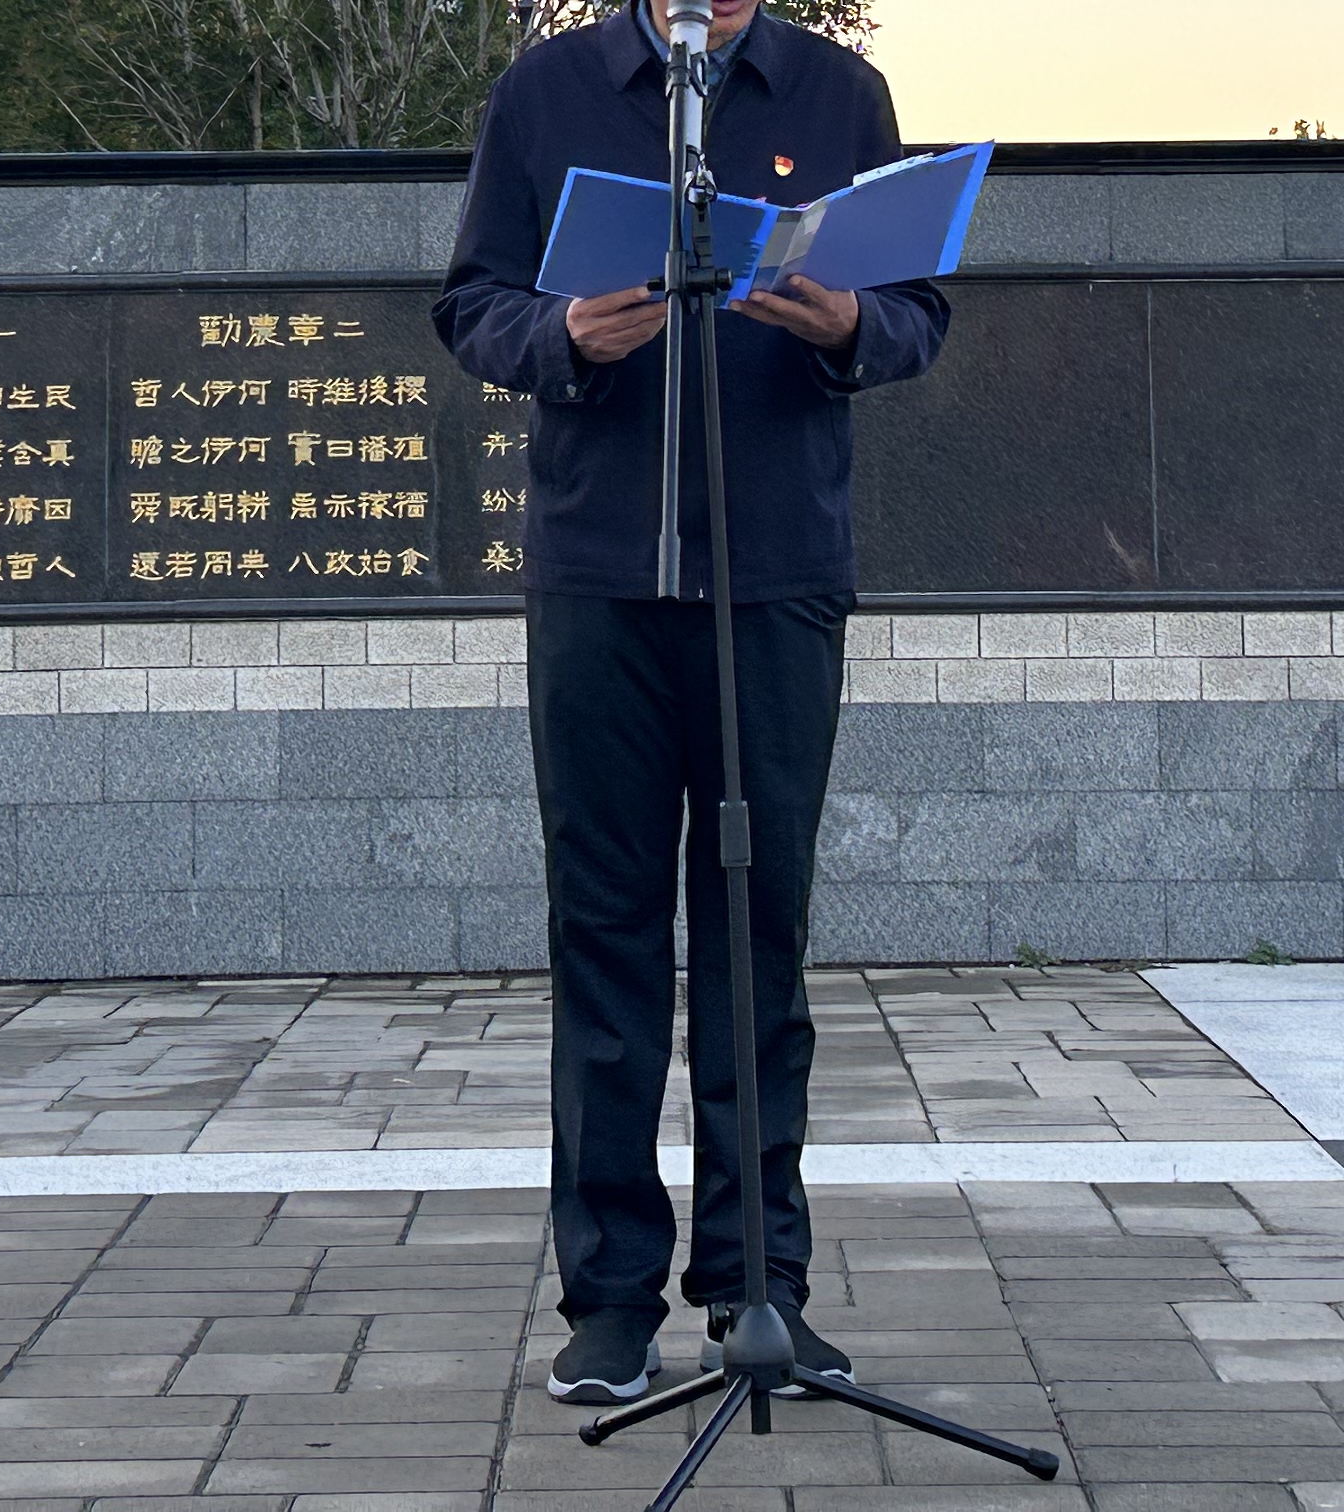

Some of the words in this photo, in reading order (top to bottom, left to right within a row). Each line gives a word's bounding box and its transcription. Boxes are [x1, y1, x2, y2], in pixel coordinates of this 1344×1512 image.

[198, 313, 365, 348] 勸農章二
[130, 377, 273, 408] 哲人伊何
[287, 375, 428, 407] 時維後稷
[130, 435, 272, 469] 贍之伊何
[129, 490, 271, 524] 舜既躬耕
[288, 546, 430, 578] 八政始食
